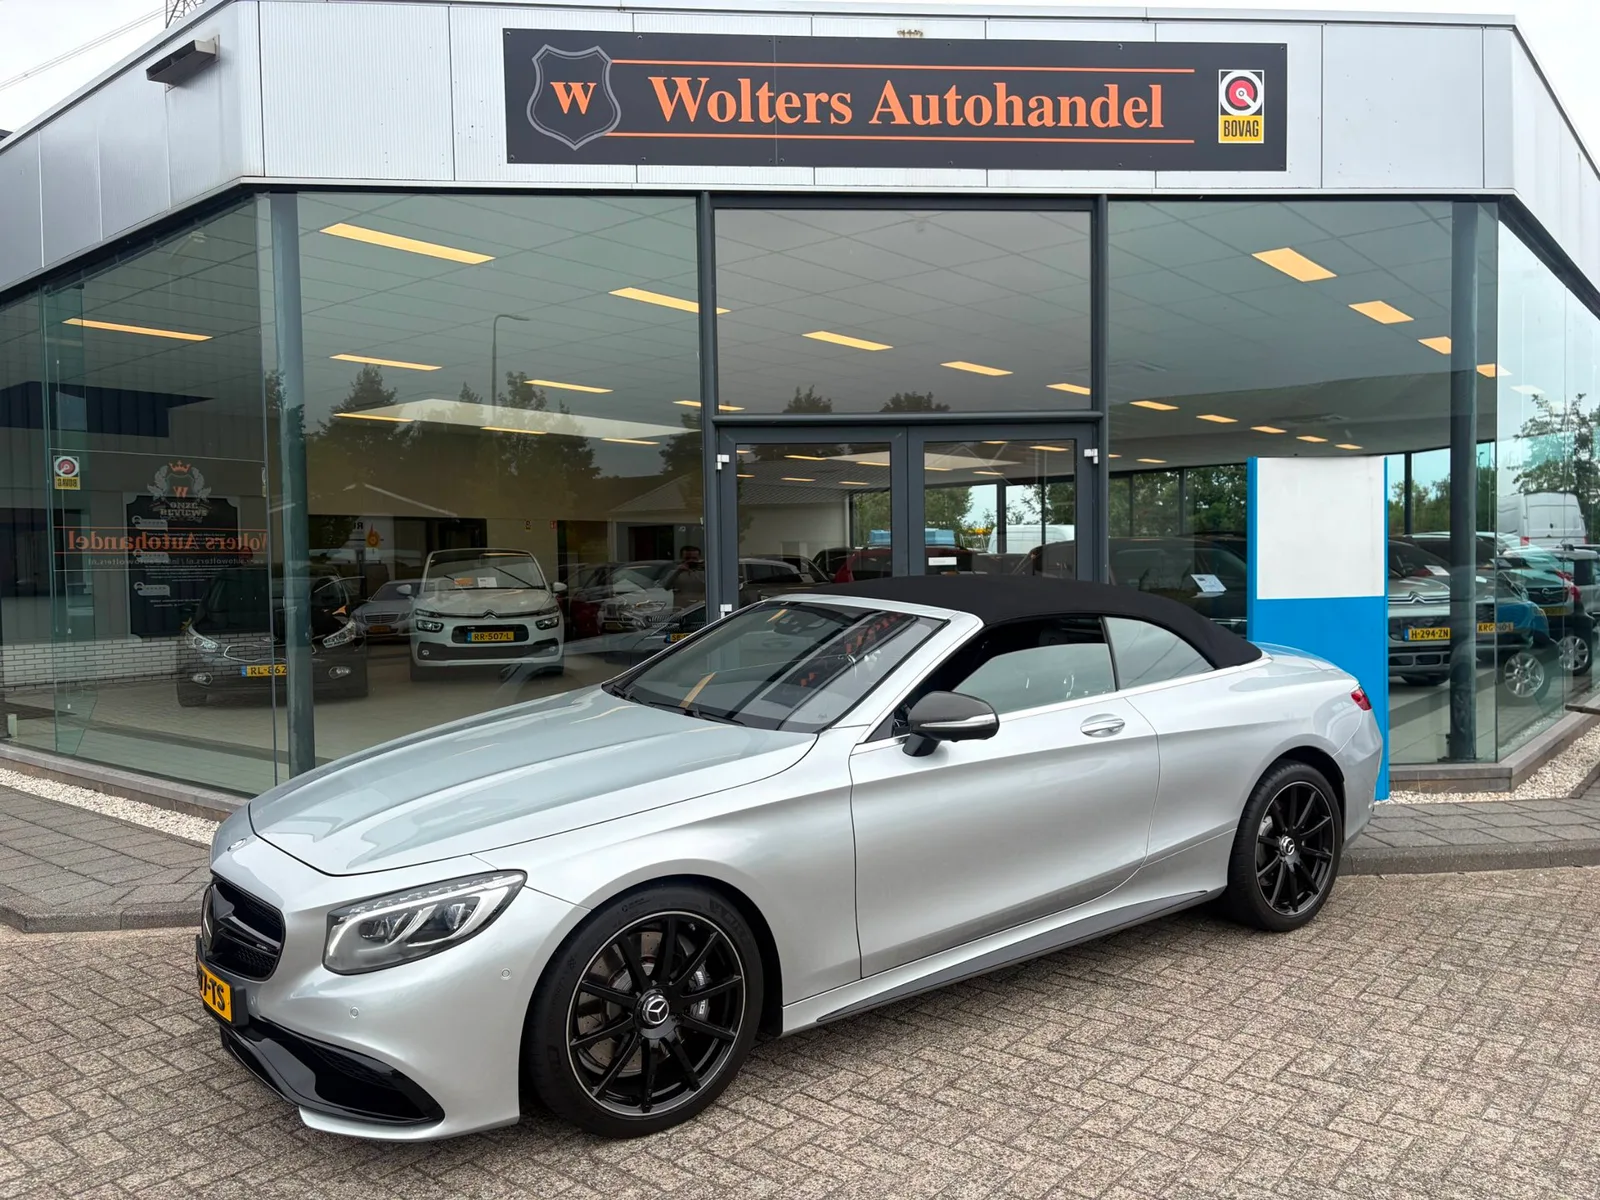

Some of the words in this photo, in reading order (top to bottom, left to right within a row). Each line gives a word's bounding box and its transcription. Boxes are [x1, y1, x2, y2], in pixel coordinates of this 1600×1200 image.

[550, 81, 596, 115] W
[648, 74, 854, 126] Wolters
[868, 79, 1165, 130] Autohandel
[1223, 120, 1259, 137] BOVAG
